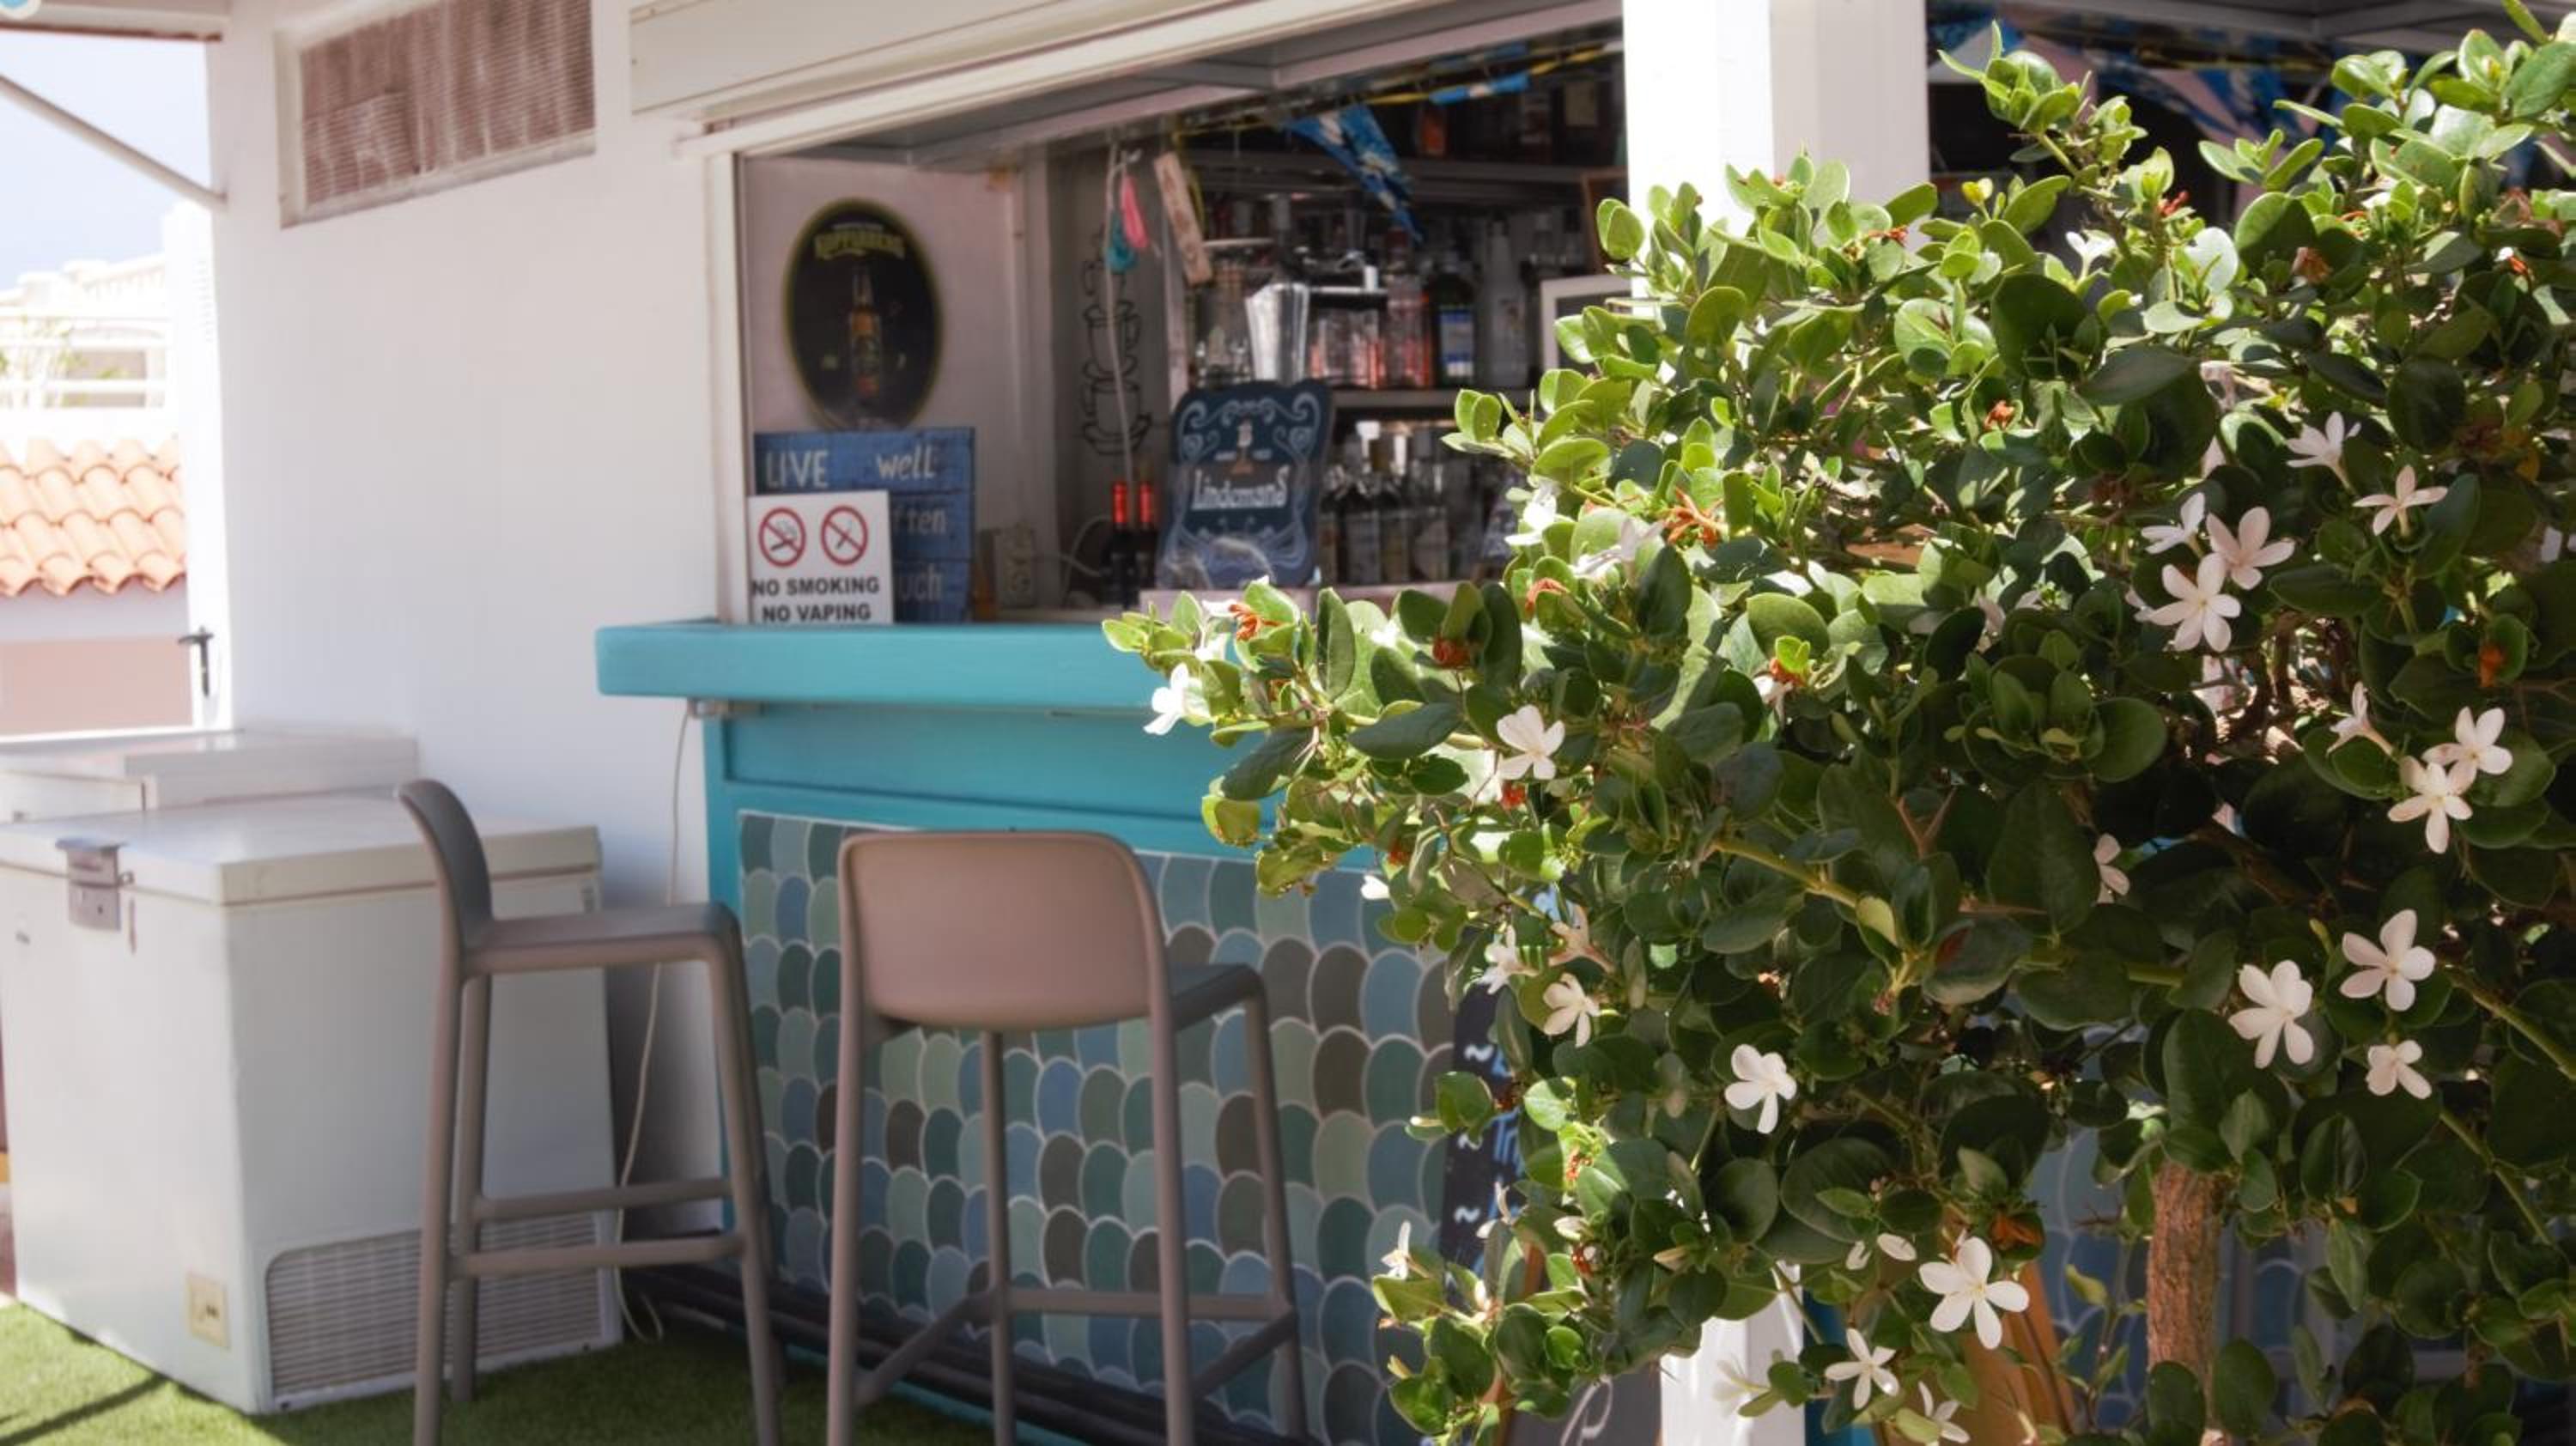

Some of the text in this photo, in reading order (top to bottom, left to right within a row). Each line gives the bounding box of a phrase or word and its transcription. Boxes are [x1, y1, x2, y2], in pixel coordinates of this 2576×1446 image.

[766, 443, 935, 489] LIVE well
[753, 576, 879, 596] NO SMOKING
[763, 603, 871, 623] NO VAPING
